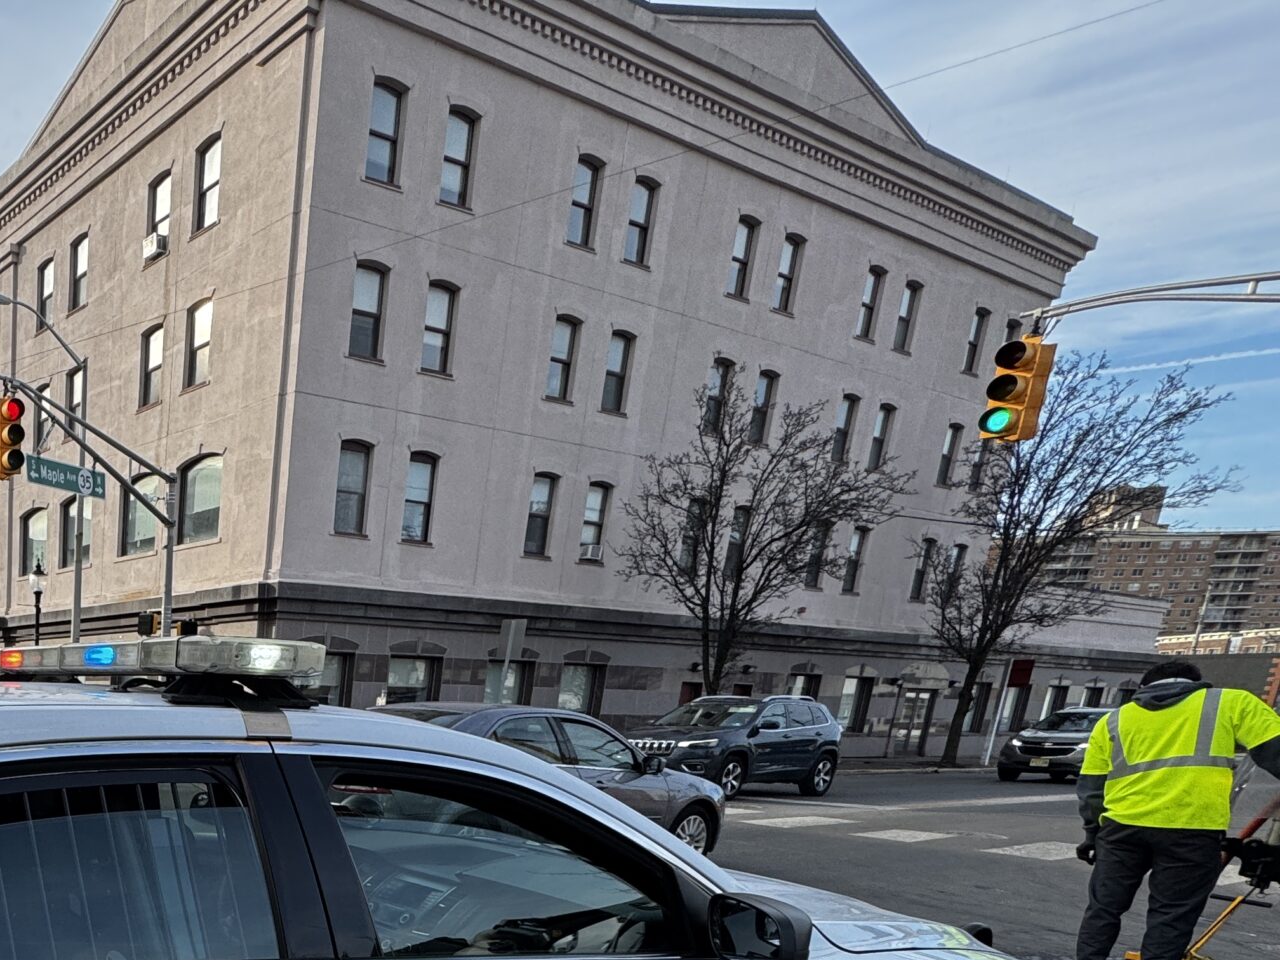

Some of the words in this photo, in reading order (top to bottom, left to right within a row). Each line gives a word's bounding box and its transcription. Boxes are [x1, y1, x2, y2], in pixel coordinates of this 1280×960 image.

[40, 463, 65, 485] Maple
[66, 471, 77, 482] Ave
[80, 474, 92, 490] 35
